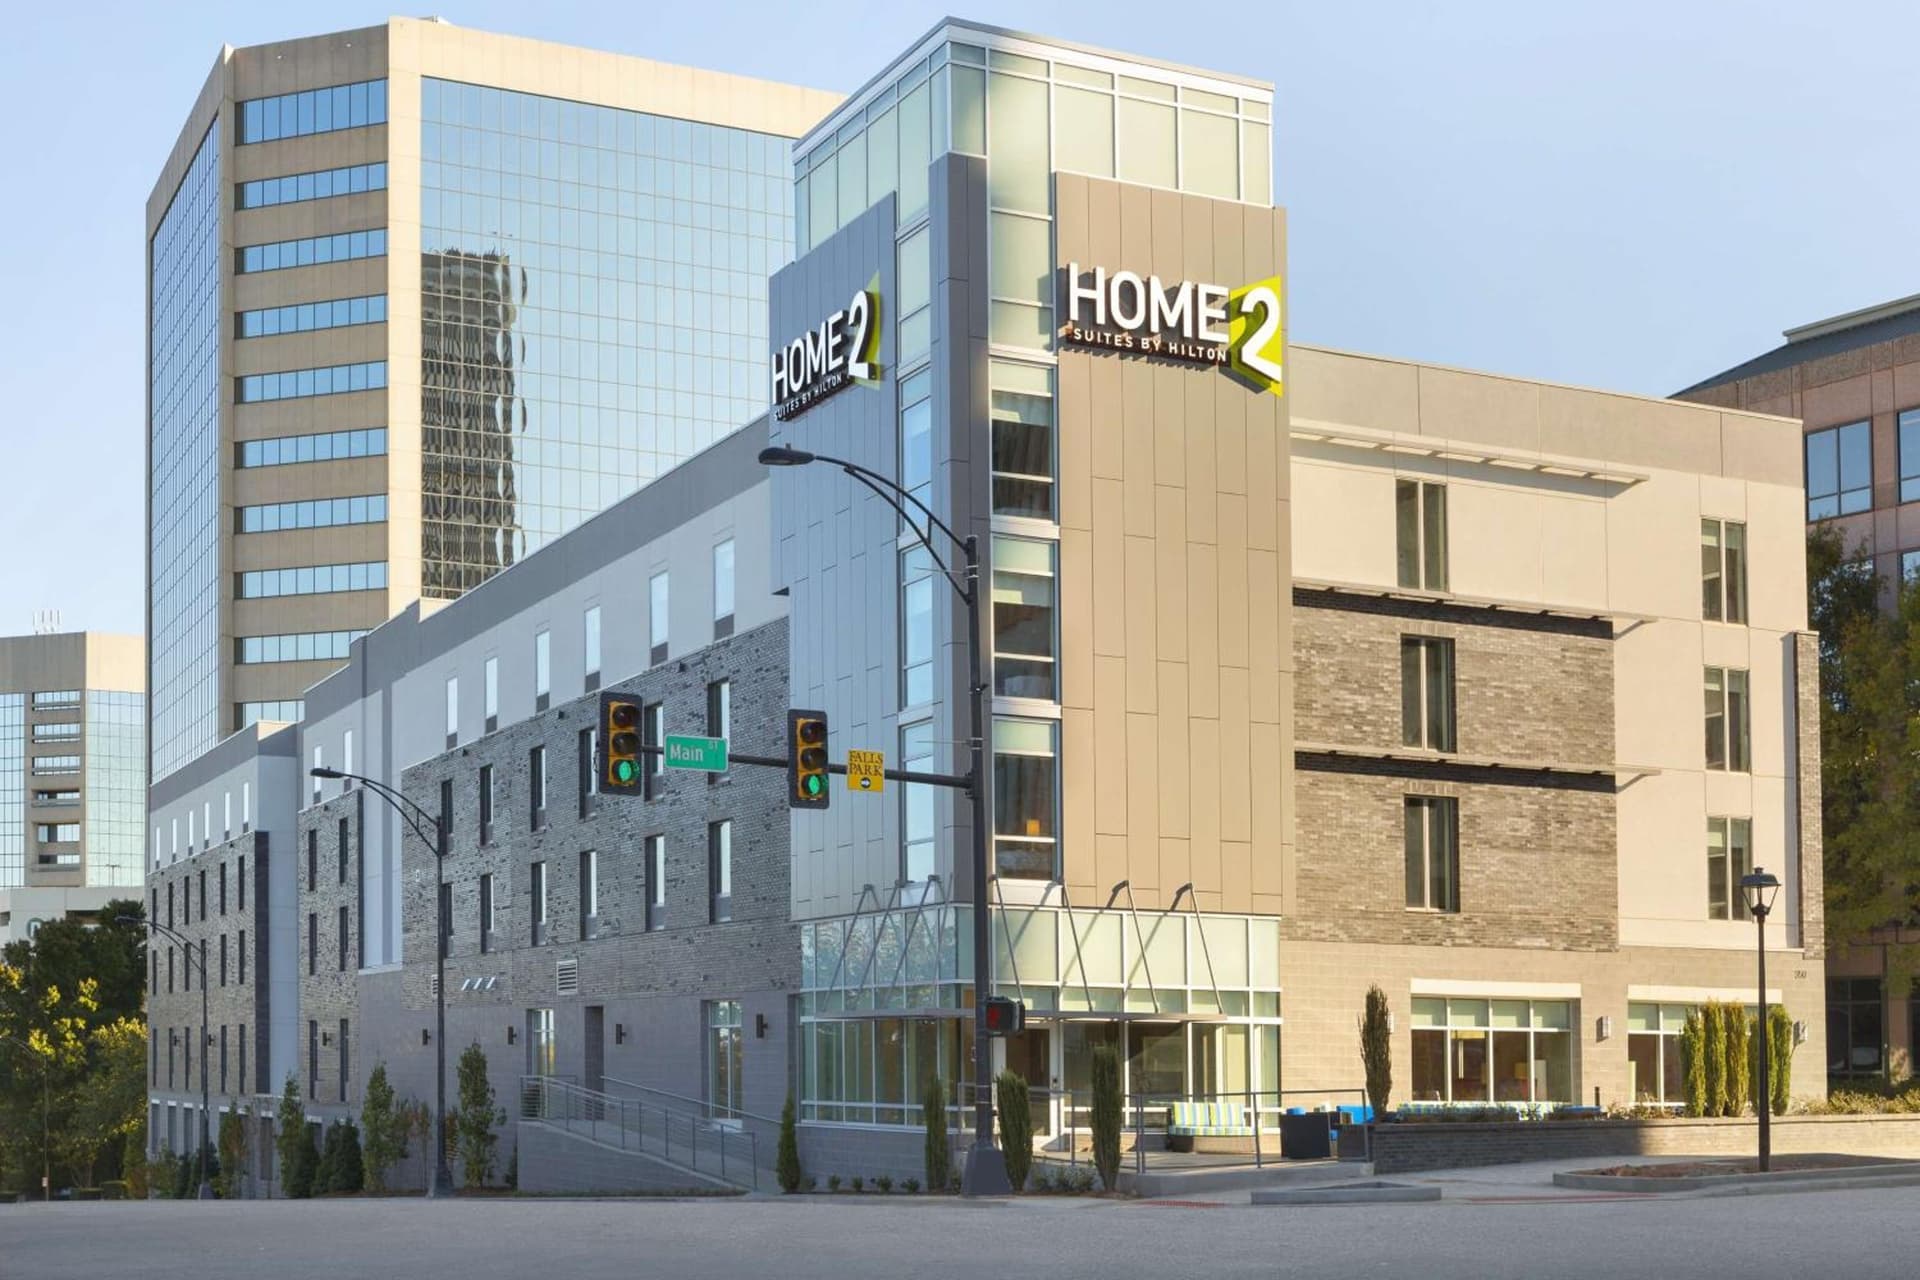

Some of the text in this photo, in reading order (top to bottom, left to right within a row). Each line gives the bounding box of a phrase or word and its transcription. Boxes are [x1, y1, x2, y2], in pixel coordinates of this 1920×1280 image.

[1069, 262, 1282, 382] HOME 2
[772, 290, 869, 405] HOME 2
[1073, 328, 1227, 362] SUITES BY HILTON
[774, 399, 800, 421] SUITES
[670, 743, 703, 762] Main
[850, 750, 883, 763] FALLS
[849, 763, 882, 776] PARK
